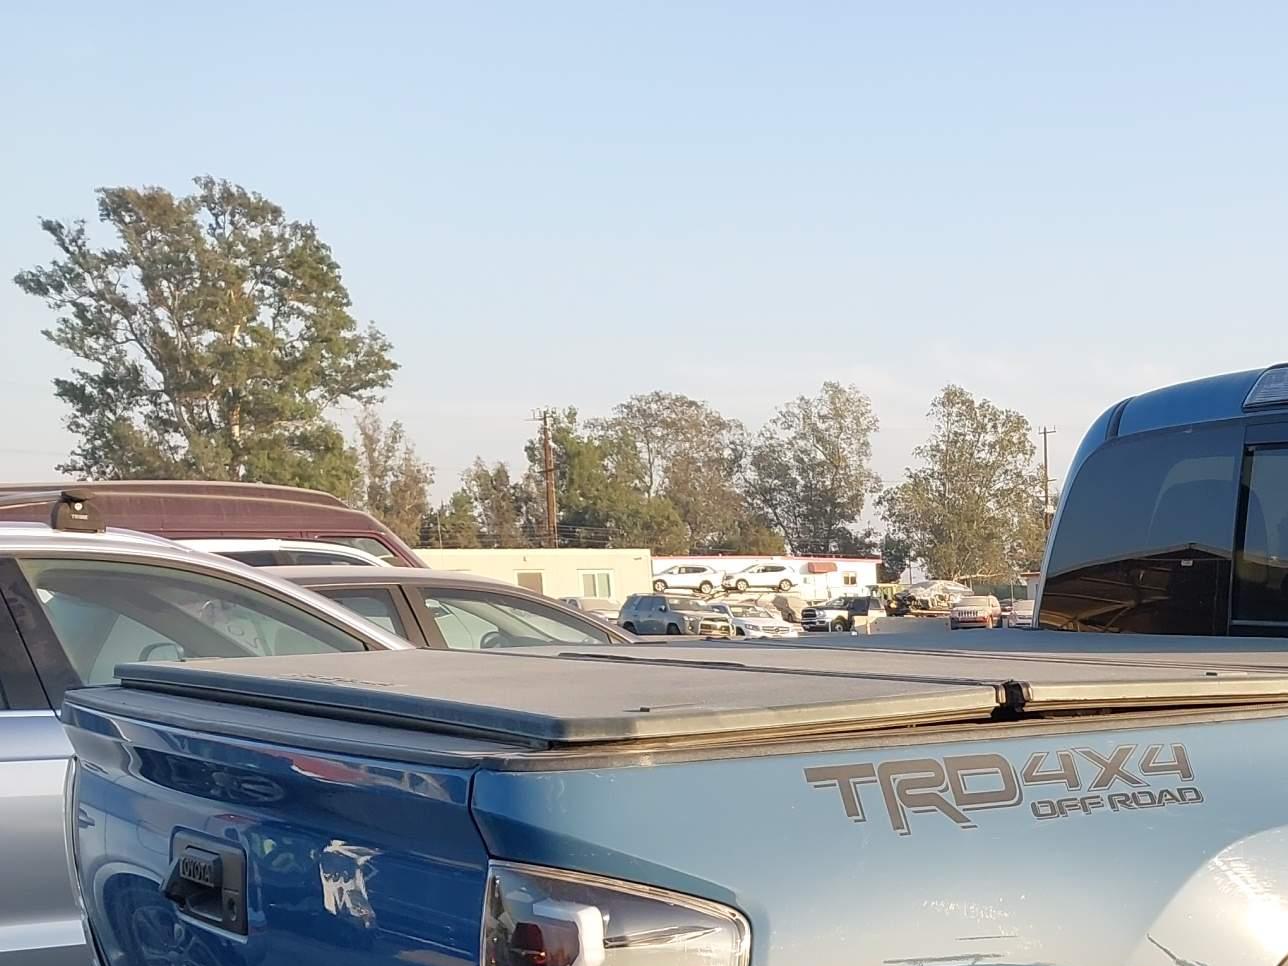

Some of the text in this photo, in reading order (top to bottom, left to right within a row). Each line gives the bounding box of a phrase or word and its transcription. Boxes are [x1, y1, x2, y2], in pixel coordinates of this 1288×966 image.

[804, 743, 1196, 836] TRD 4X4
[1031, 786, 1204, 820] OFF ROAD
[181, 857, 214, 888] TOYOTA
